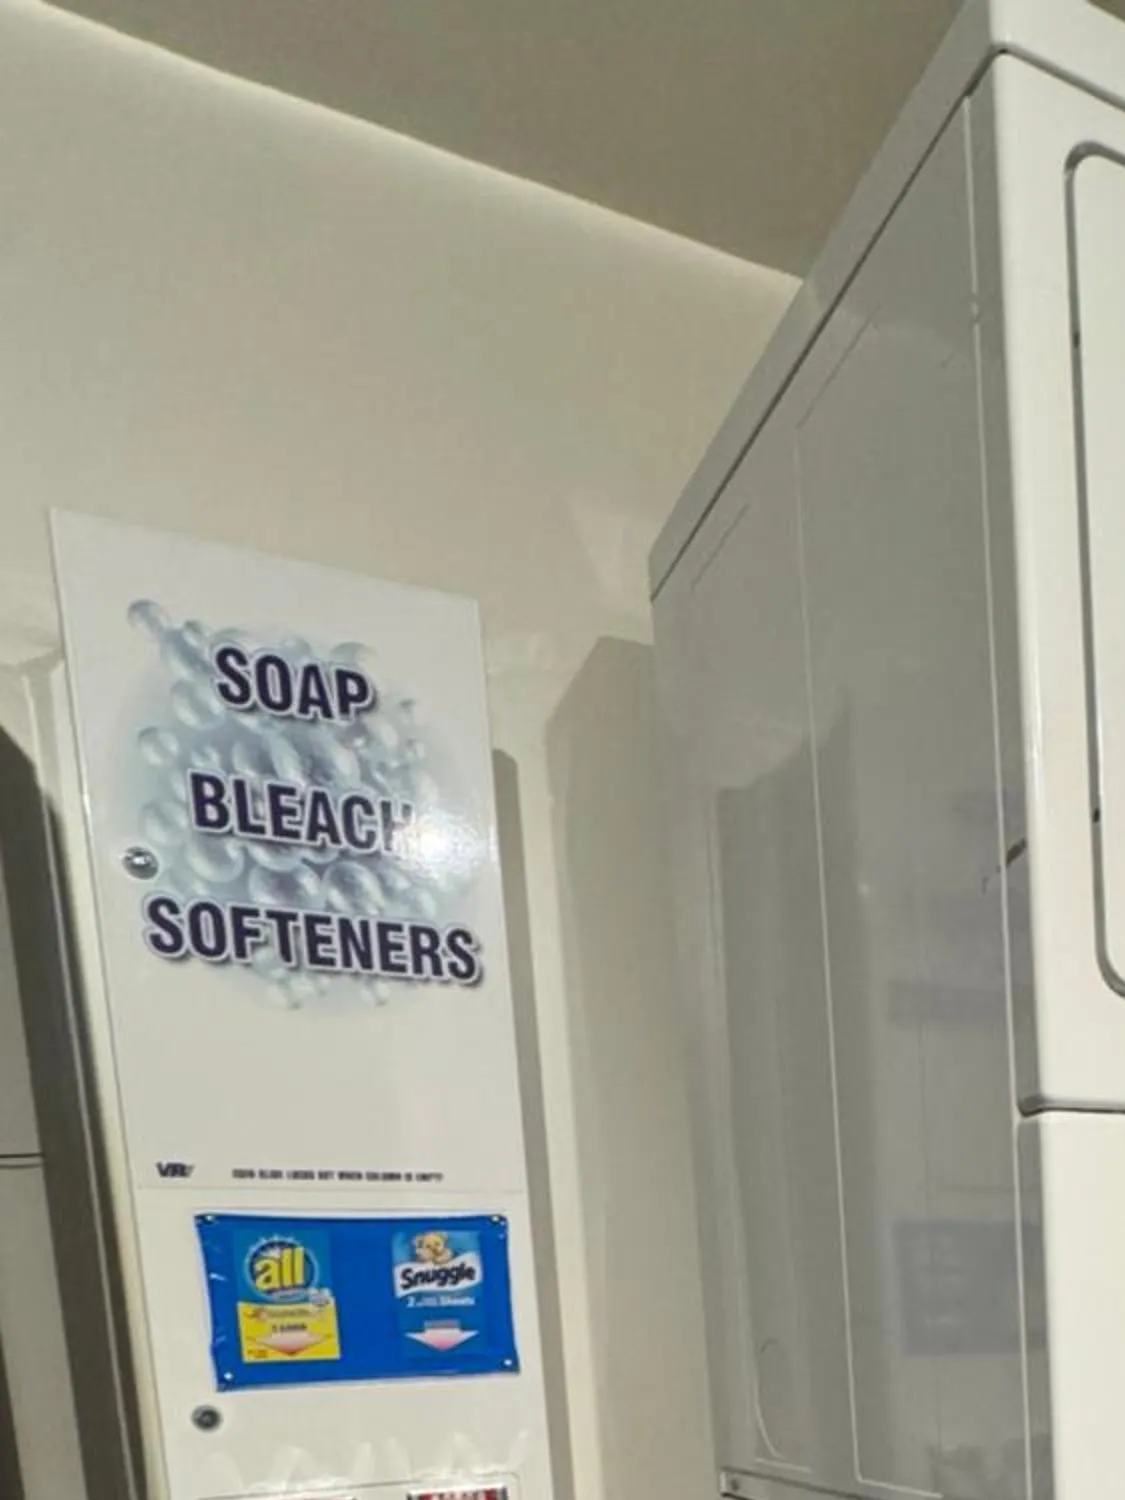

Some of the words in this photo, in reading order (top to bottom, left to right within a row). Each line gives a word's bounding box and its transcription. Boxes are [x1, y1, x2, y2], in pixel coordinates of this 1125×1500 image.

[214, 646, 374, 720] SOAP
[188, 772, 412, 853] BLEACH
[147, 896, 480, 983] SOFTENERS
[254, 1247, 304, 1291] all
[400, 1262, 476, 1290] Snuggle
